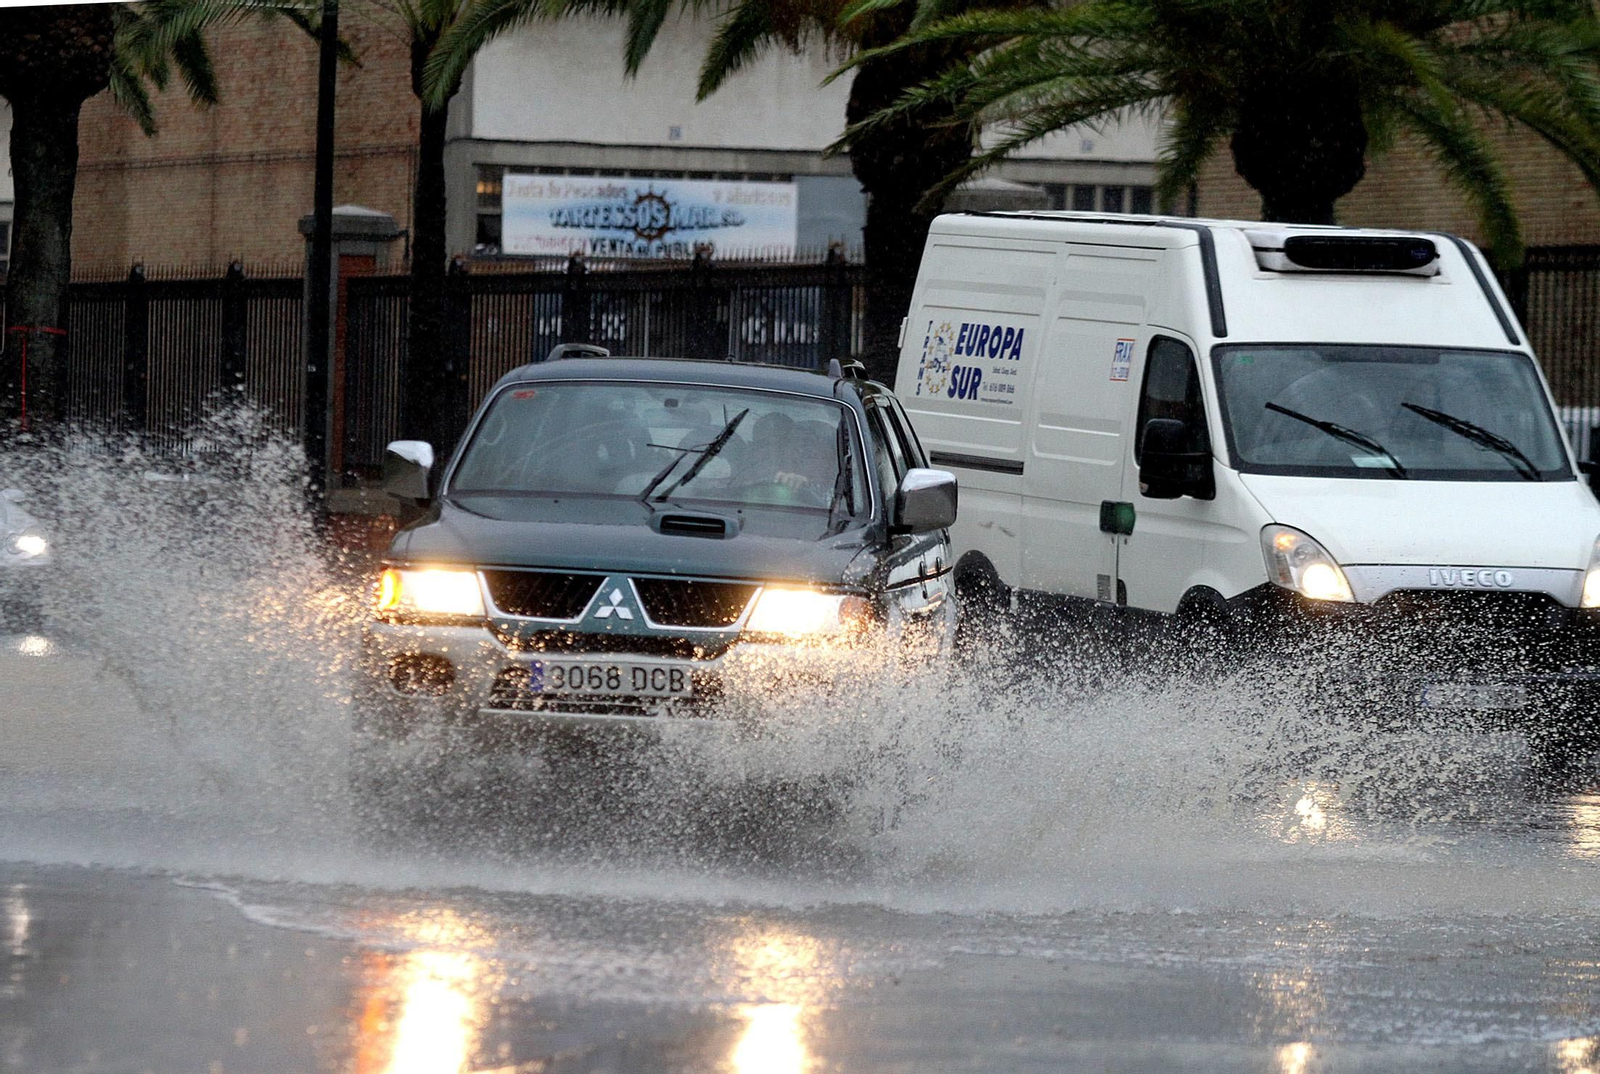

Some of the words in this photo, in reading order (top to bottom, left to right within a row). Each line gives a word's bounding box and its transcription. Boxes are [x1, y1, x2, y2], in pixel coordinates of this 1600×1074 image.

[916, 320, 934, 396] TRANS
[954, 322, 1025, 361] EUROPA
[947, 365, 982, 401] SUR
[1428, 568, 1513, 588] IVECO
[550, 665, 621, 691] 3068
[631, 666, 685, 692] DCB
